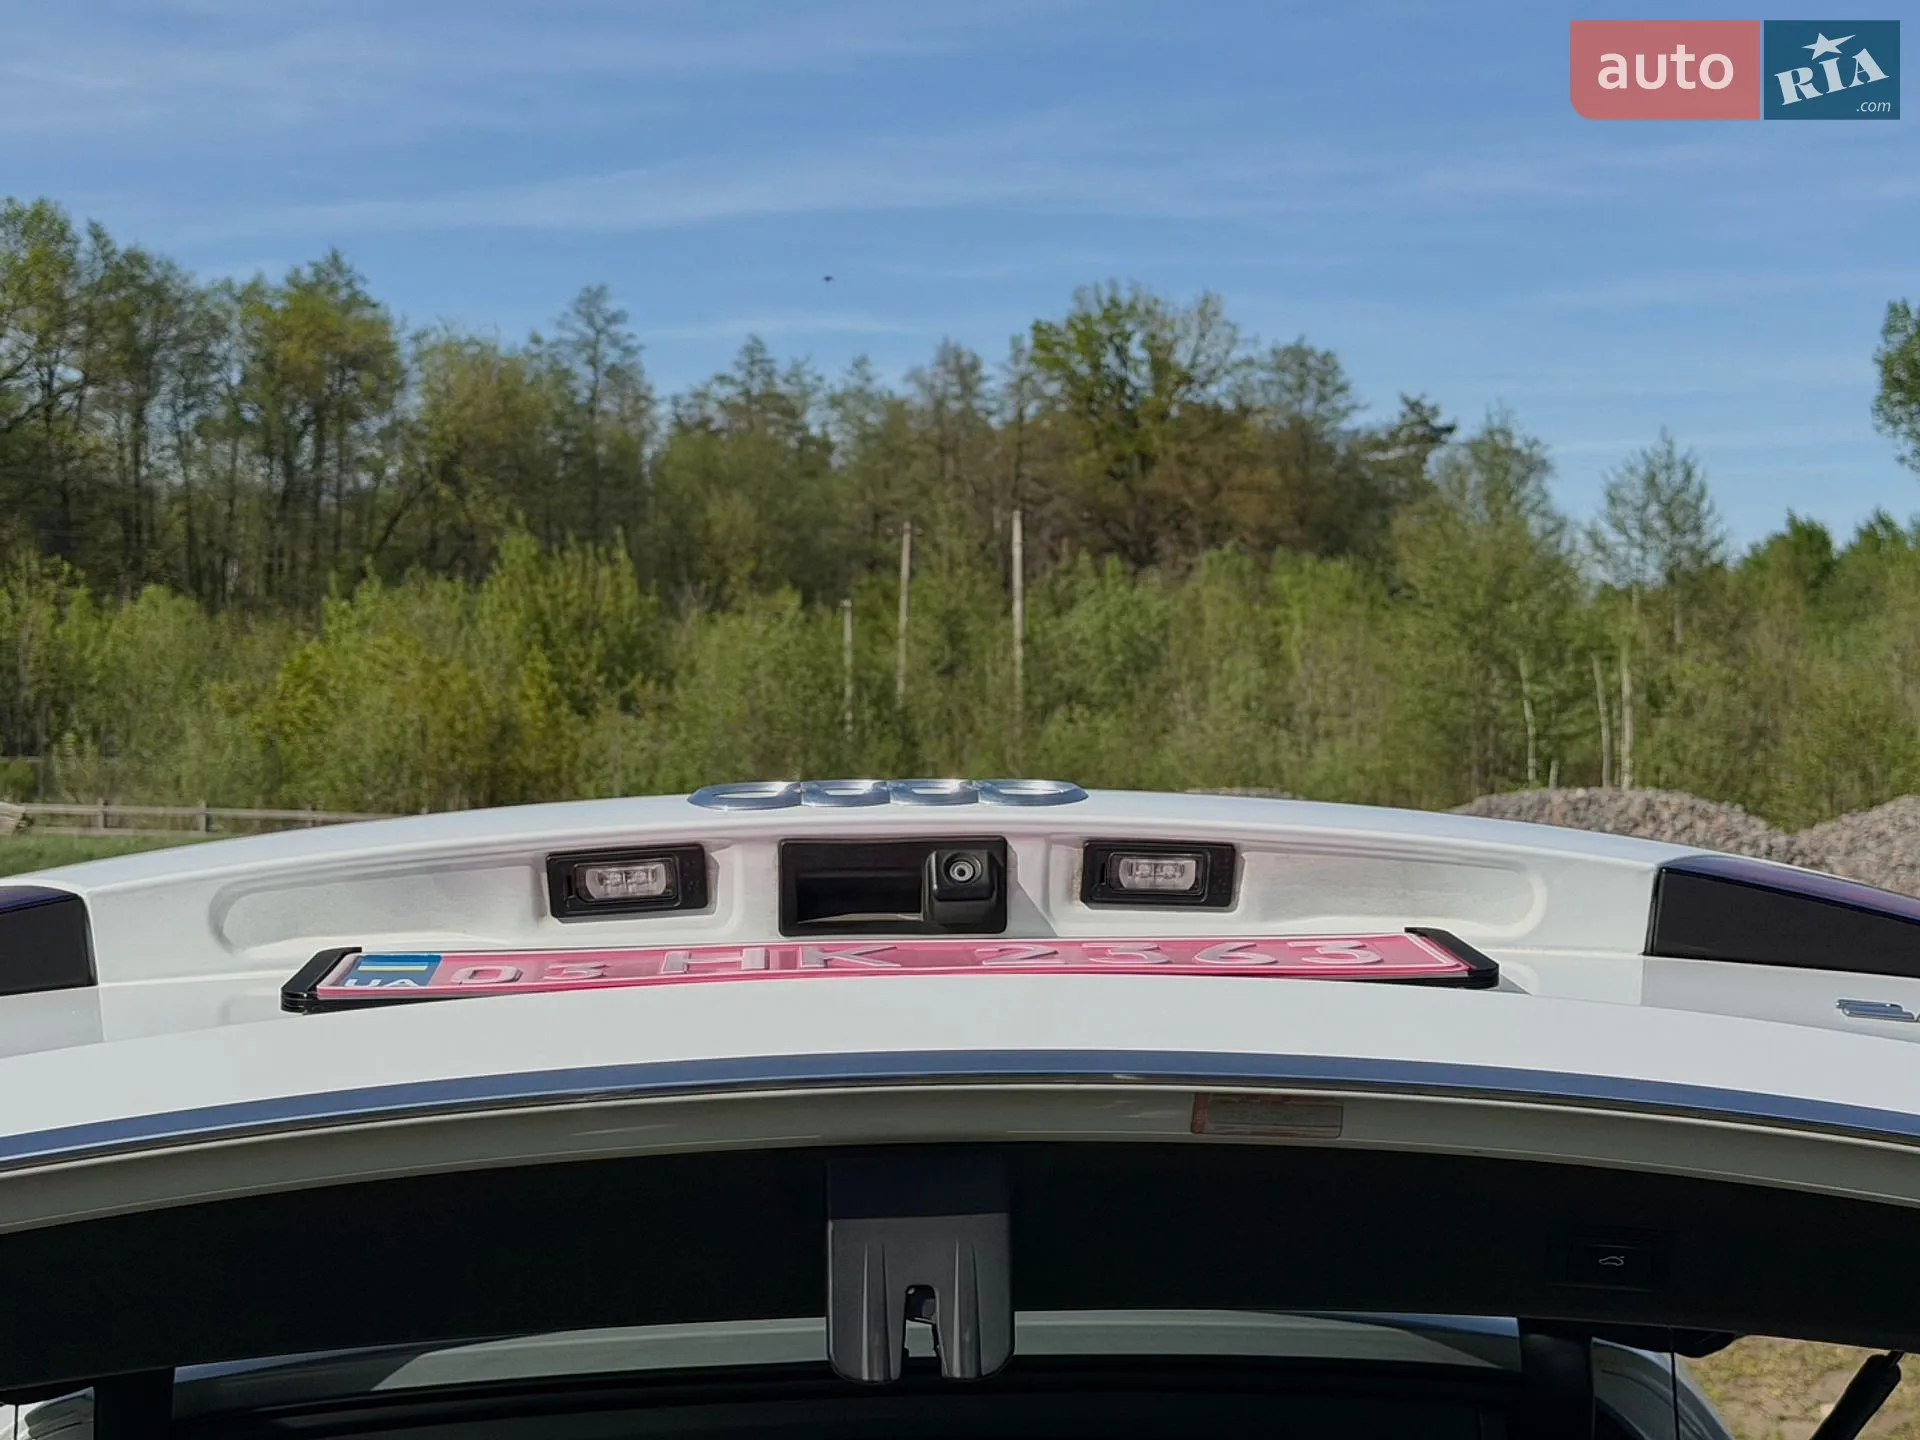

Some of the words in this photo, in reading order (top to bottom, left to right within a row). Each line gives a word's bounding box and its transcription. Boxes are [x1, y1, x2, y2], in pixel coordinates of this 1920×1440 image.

[451, 963, 611, 984] 03
[661, 945, 901, 974] HK
[975, 942, 1384, 965] 2363
[343, 978, 420, 988] UA
